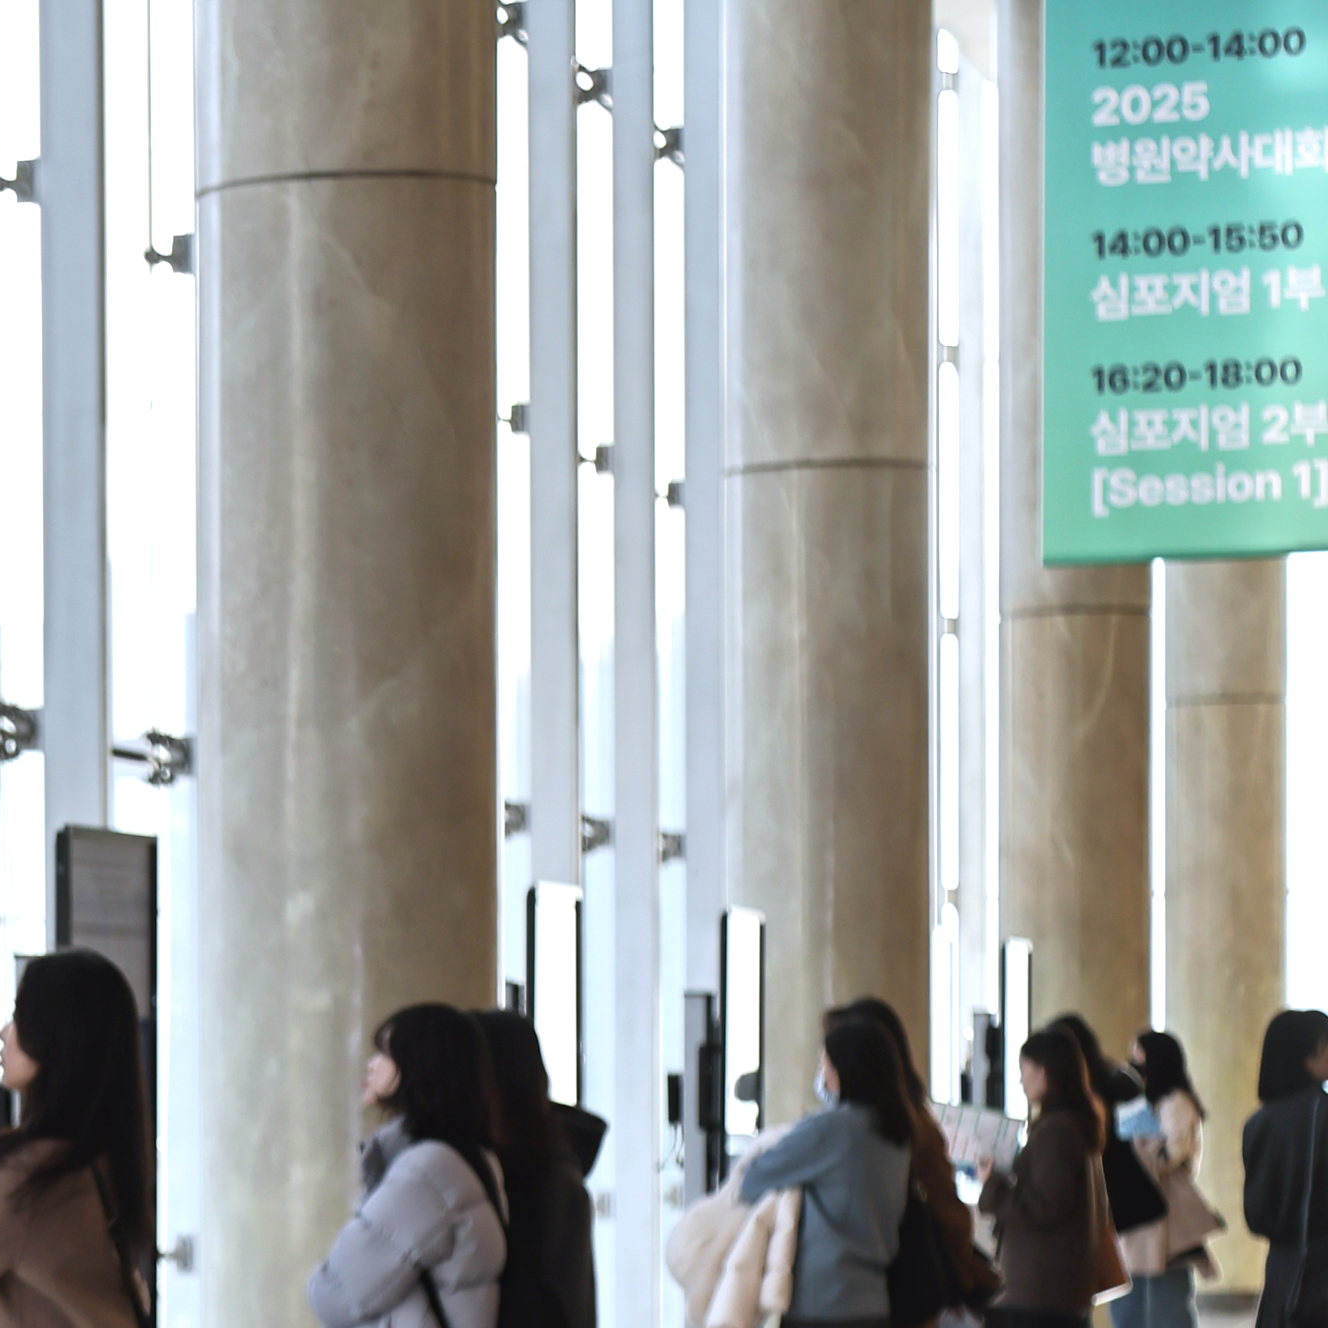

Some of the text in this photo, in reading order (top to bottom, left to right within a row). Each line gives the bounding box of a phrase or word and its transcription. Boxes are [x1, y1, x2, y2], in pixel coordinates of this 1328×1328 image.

[1093, 27, 1307, 69] 12:00-14:00
[1091, 81, 1210, 127] 2025
[1091, 127, 1328, 187] 병원약사대회
[1093, 221, 1304, 260] 14:00-15:50
[1091, 264, 1325, 322] 심포지엄 1부
[1093, 356, 1303, 396] 16:20-18:00
[1091, 399, 1328, 457] 심포지엄 2부
[1092, 461, 1283, 517] [Session
